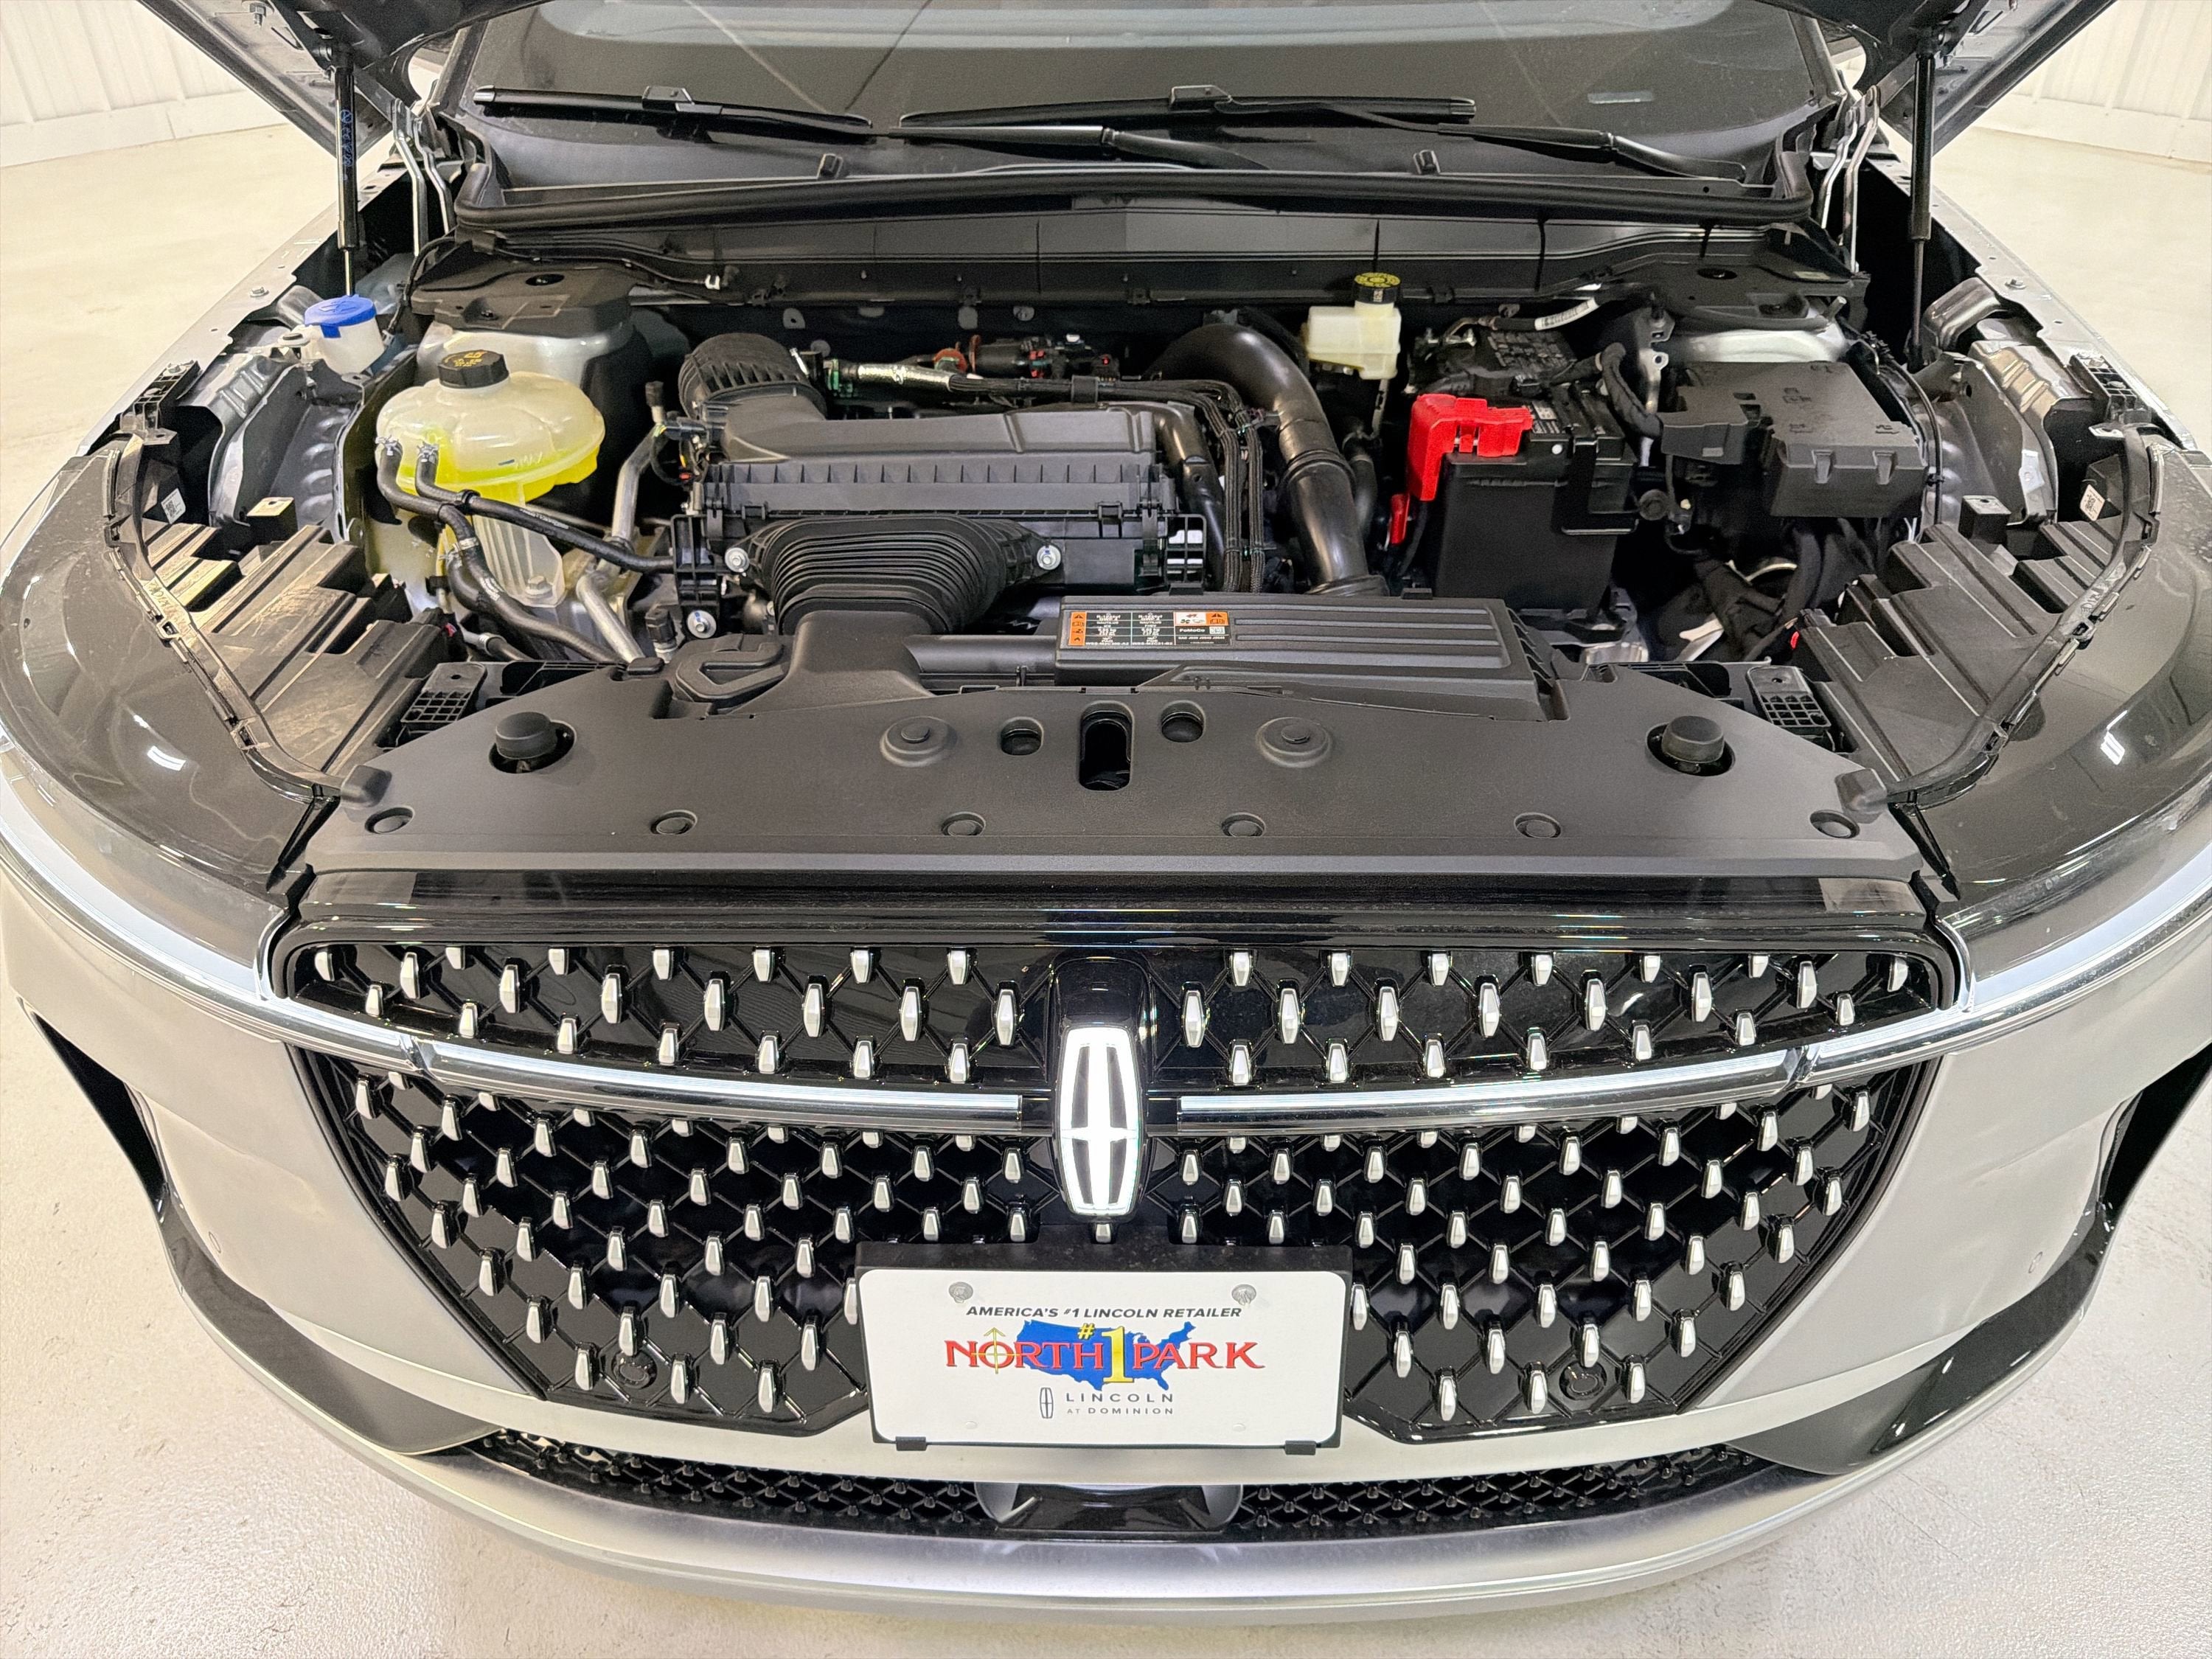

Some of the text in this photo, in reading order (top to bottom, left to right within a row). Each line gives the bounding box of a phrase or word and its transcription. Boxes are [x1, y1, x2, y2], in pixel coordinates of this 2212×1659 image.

[967, 1306, 1242, 1318] AMERICA'S #1 LINCOLN RETAILER
[944, 1340, 1104, 1369] NORTH
[1133, 1341, 1266, 1369] PARK
[1066, 1393, 1173, 1402] LINCOLN
